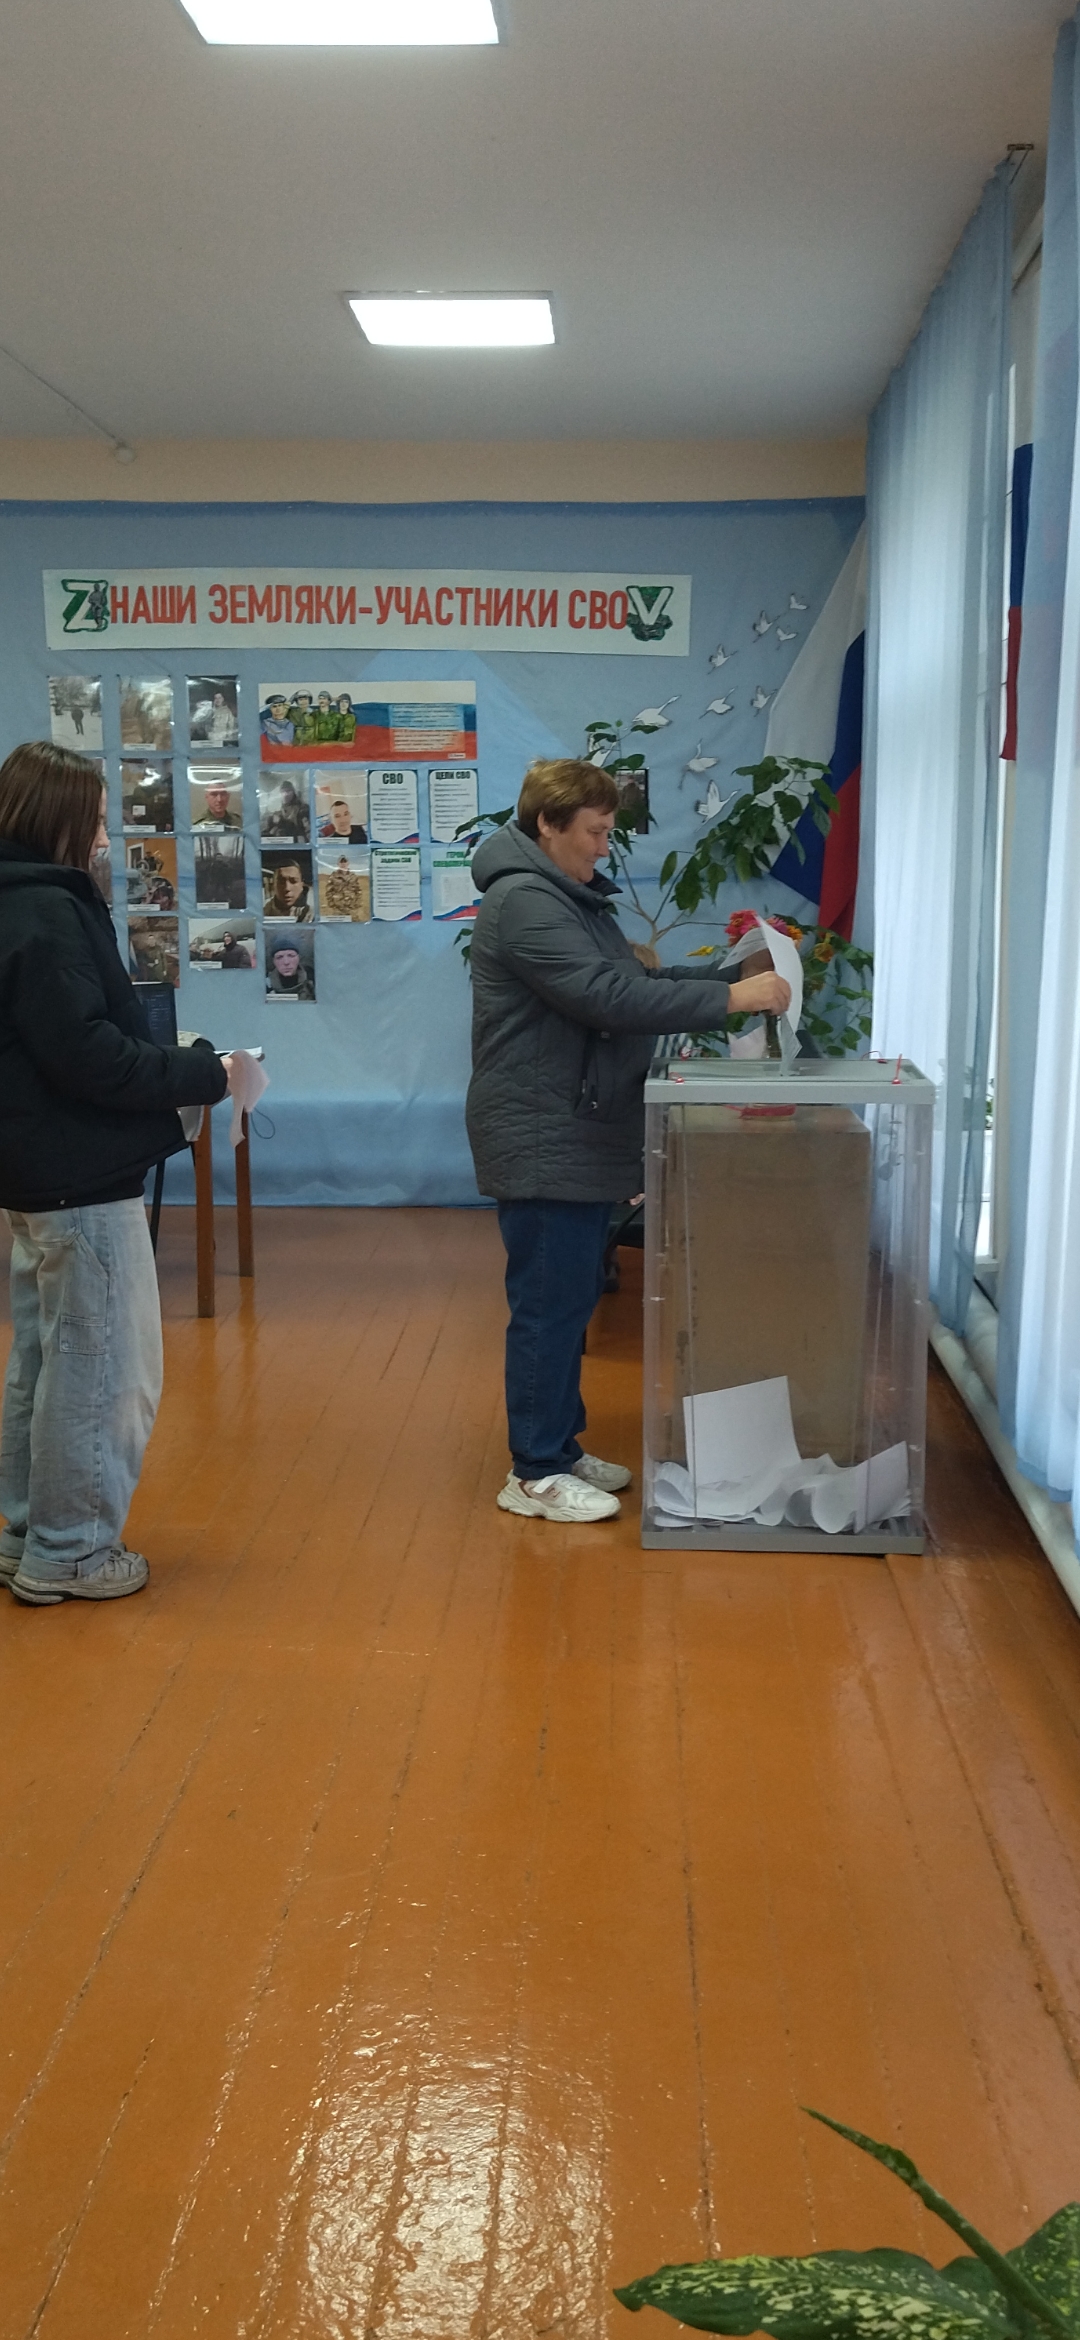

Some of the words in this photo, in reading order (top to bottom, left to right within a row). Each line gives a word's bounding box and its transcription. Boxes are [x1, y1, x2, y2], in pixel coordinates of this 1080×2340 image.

[110, 585, 197, 625] НАШИ
[208, 583, 558, 628] ЗЕМЛЯКИ-УЧАСТНИКИ
[568, 589, 629, 630] СВО
[382, 772, 404, 785] СВО
[455, 771, 471, 780] СВО
